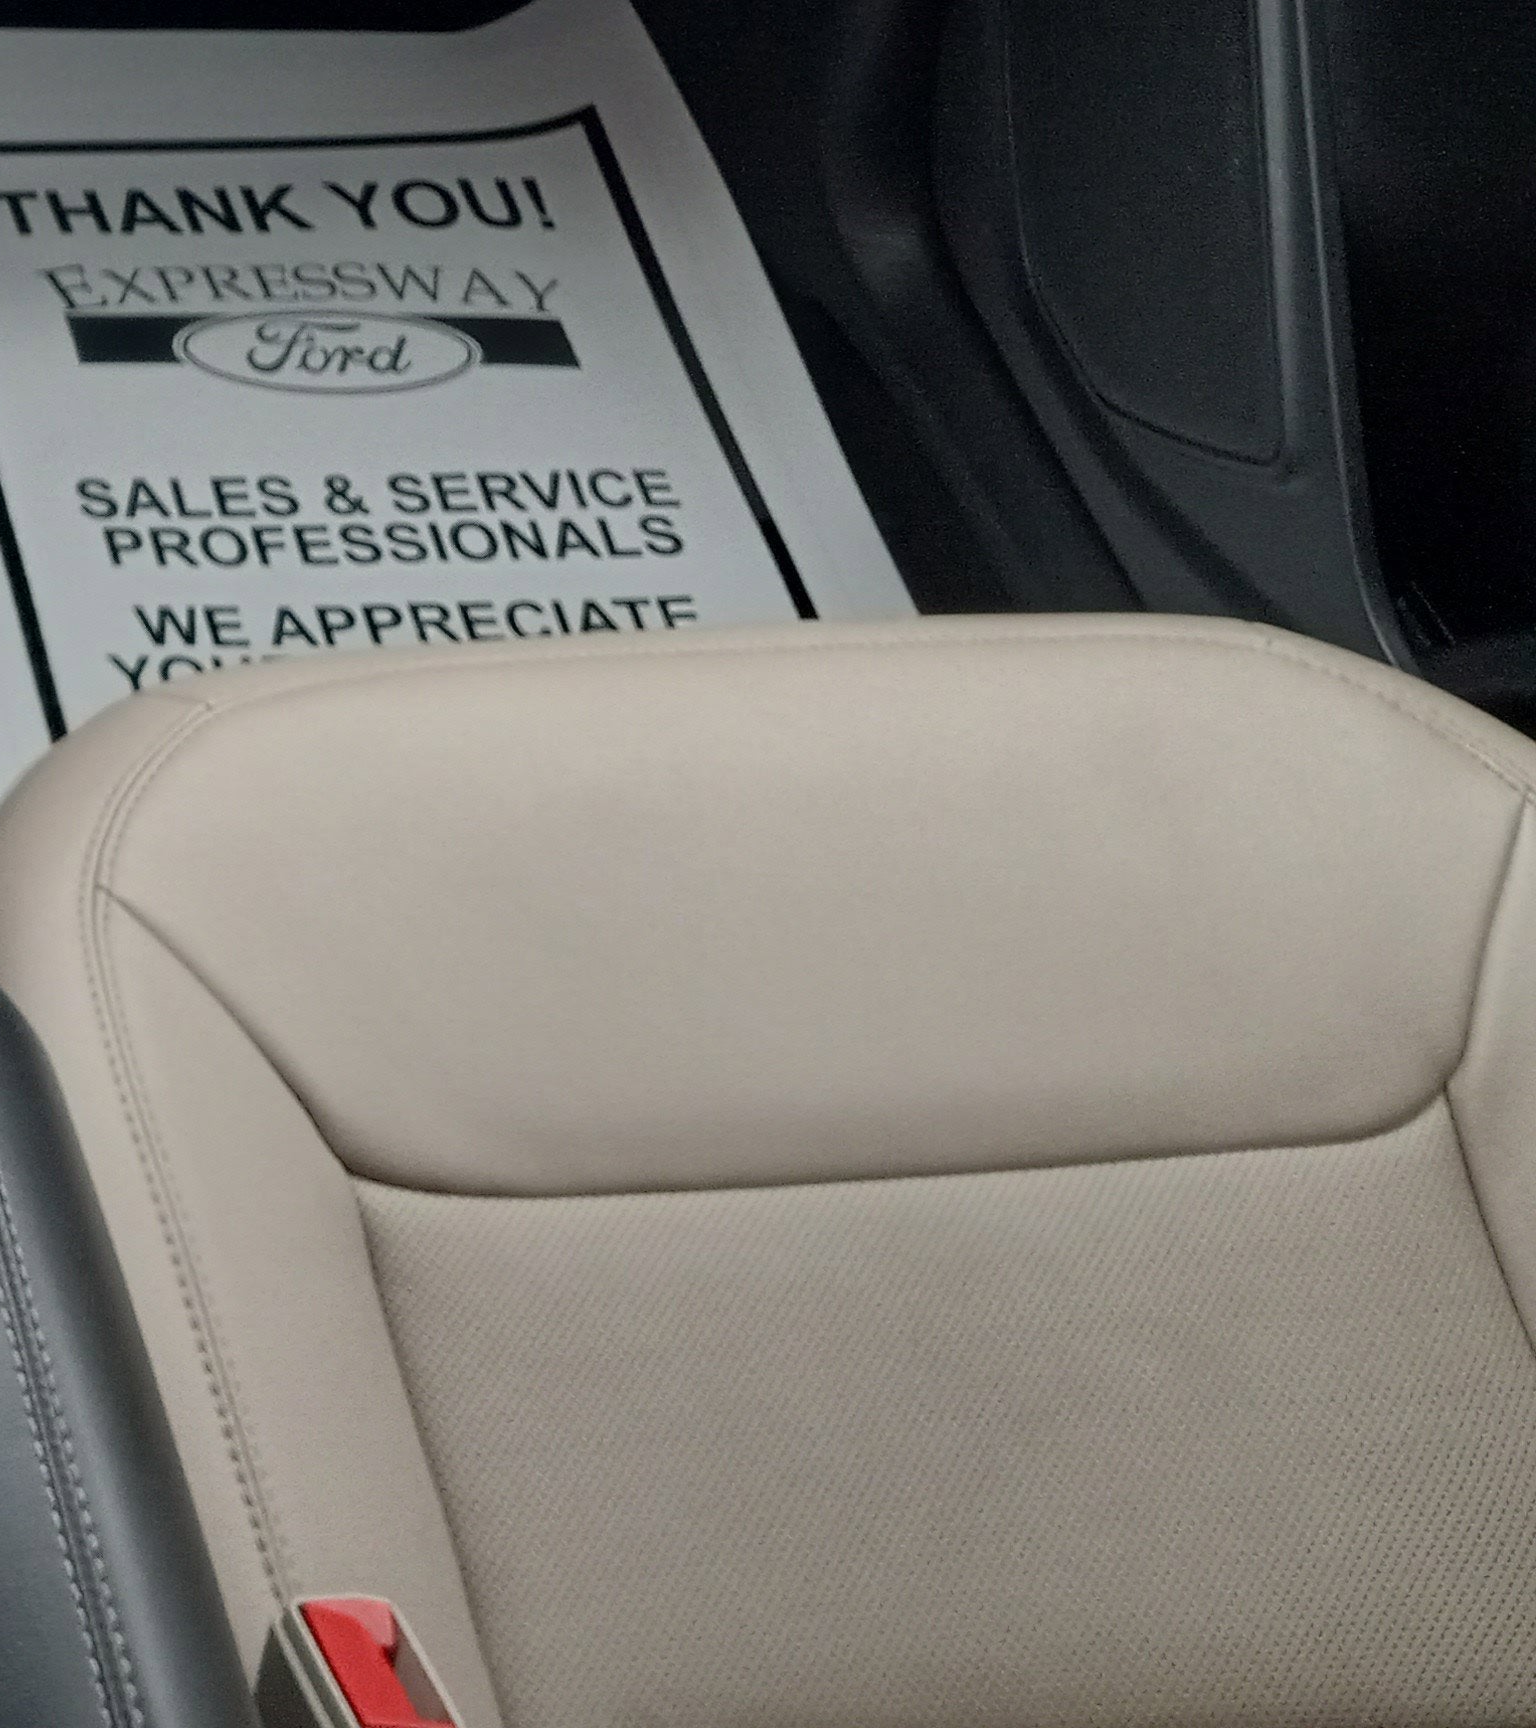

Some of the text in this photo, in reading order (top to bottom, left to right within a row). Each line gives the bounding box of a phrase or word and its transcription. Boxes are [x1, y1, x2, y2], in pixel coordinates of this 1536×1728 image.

[326, 176, 559, 232] YOU!
[41, 261, 561, 315] EXPRESSWAY
[245, 319, 412, 374] Ford
[75, 467, 683, 519] SALES & SERVICE
[101, 516, 685, 568] PROFESSIONALS
[134, 594, 700, 648] WE APPRECIATE
